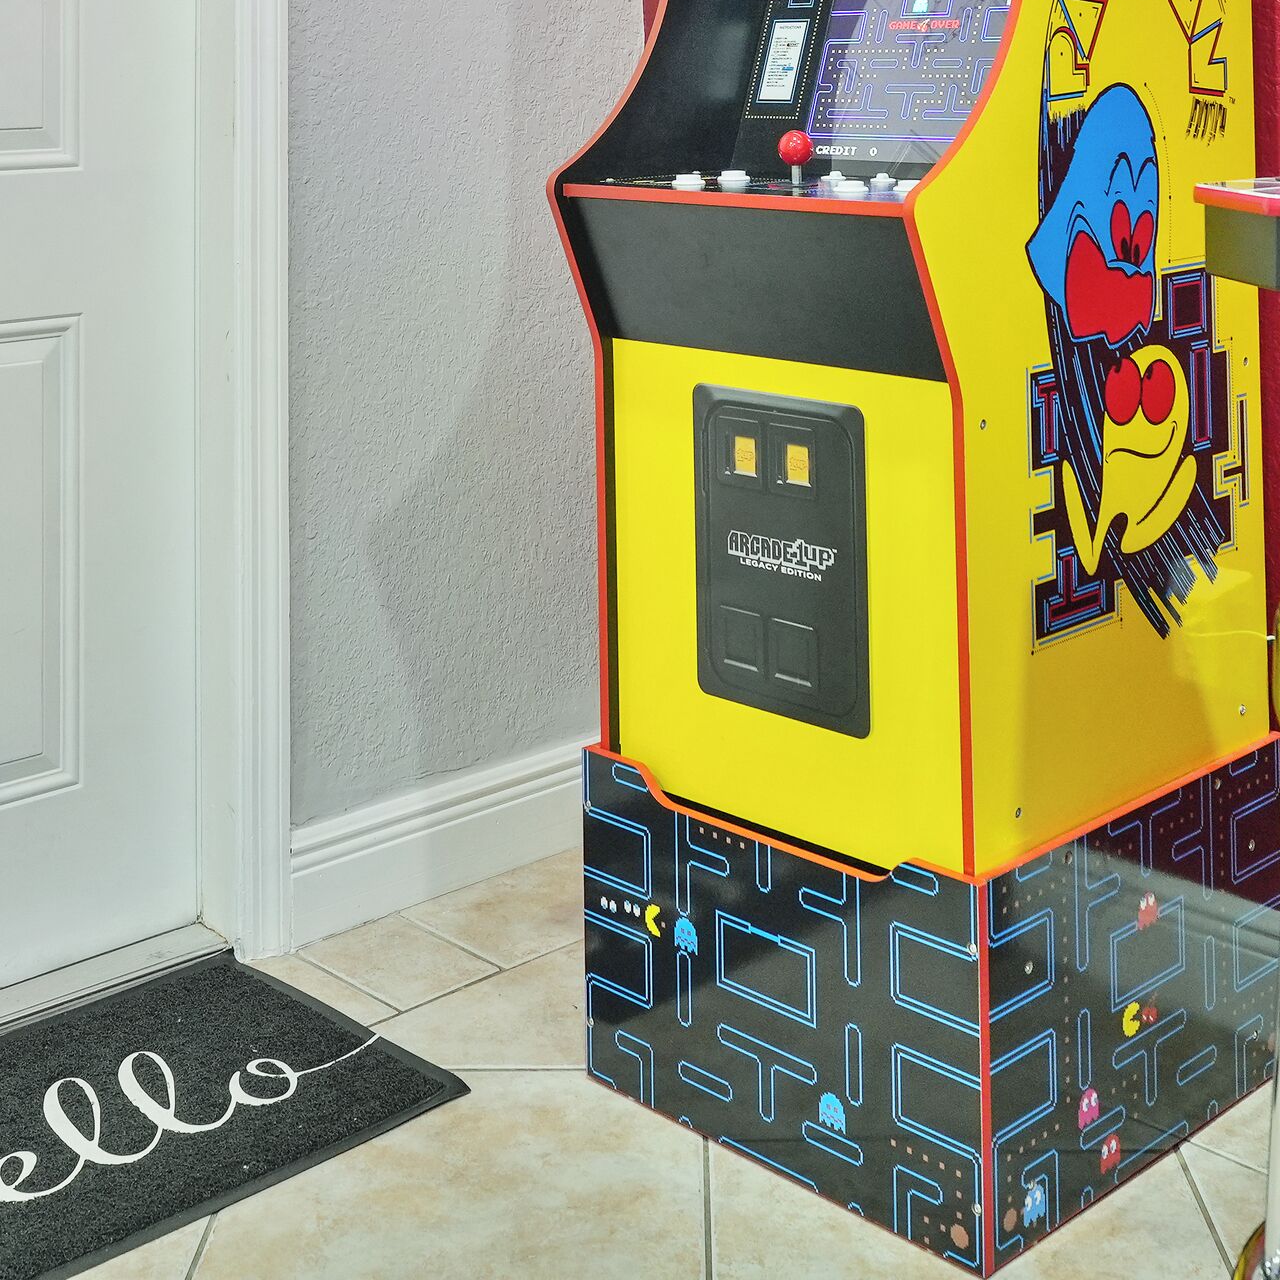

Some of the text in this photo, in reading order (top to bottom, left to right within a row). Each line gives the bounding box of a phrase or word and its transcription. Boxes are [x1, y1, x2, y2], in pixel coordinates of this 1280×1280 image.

[888, 19, 961, 30] GAME OVER
[815, 145, 858, 157] CREDIT
[727, 529, 835, 571] ARCADE1UP
[739, 557, 822, 582] LEGACY EDITION
